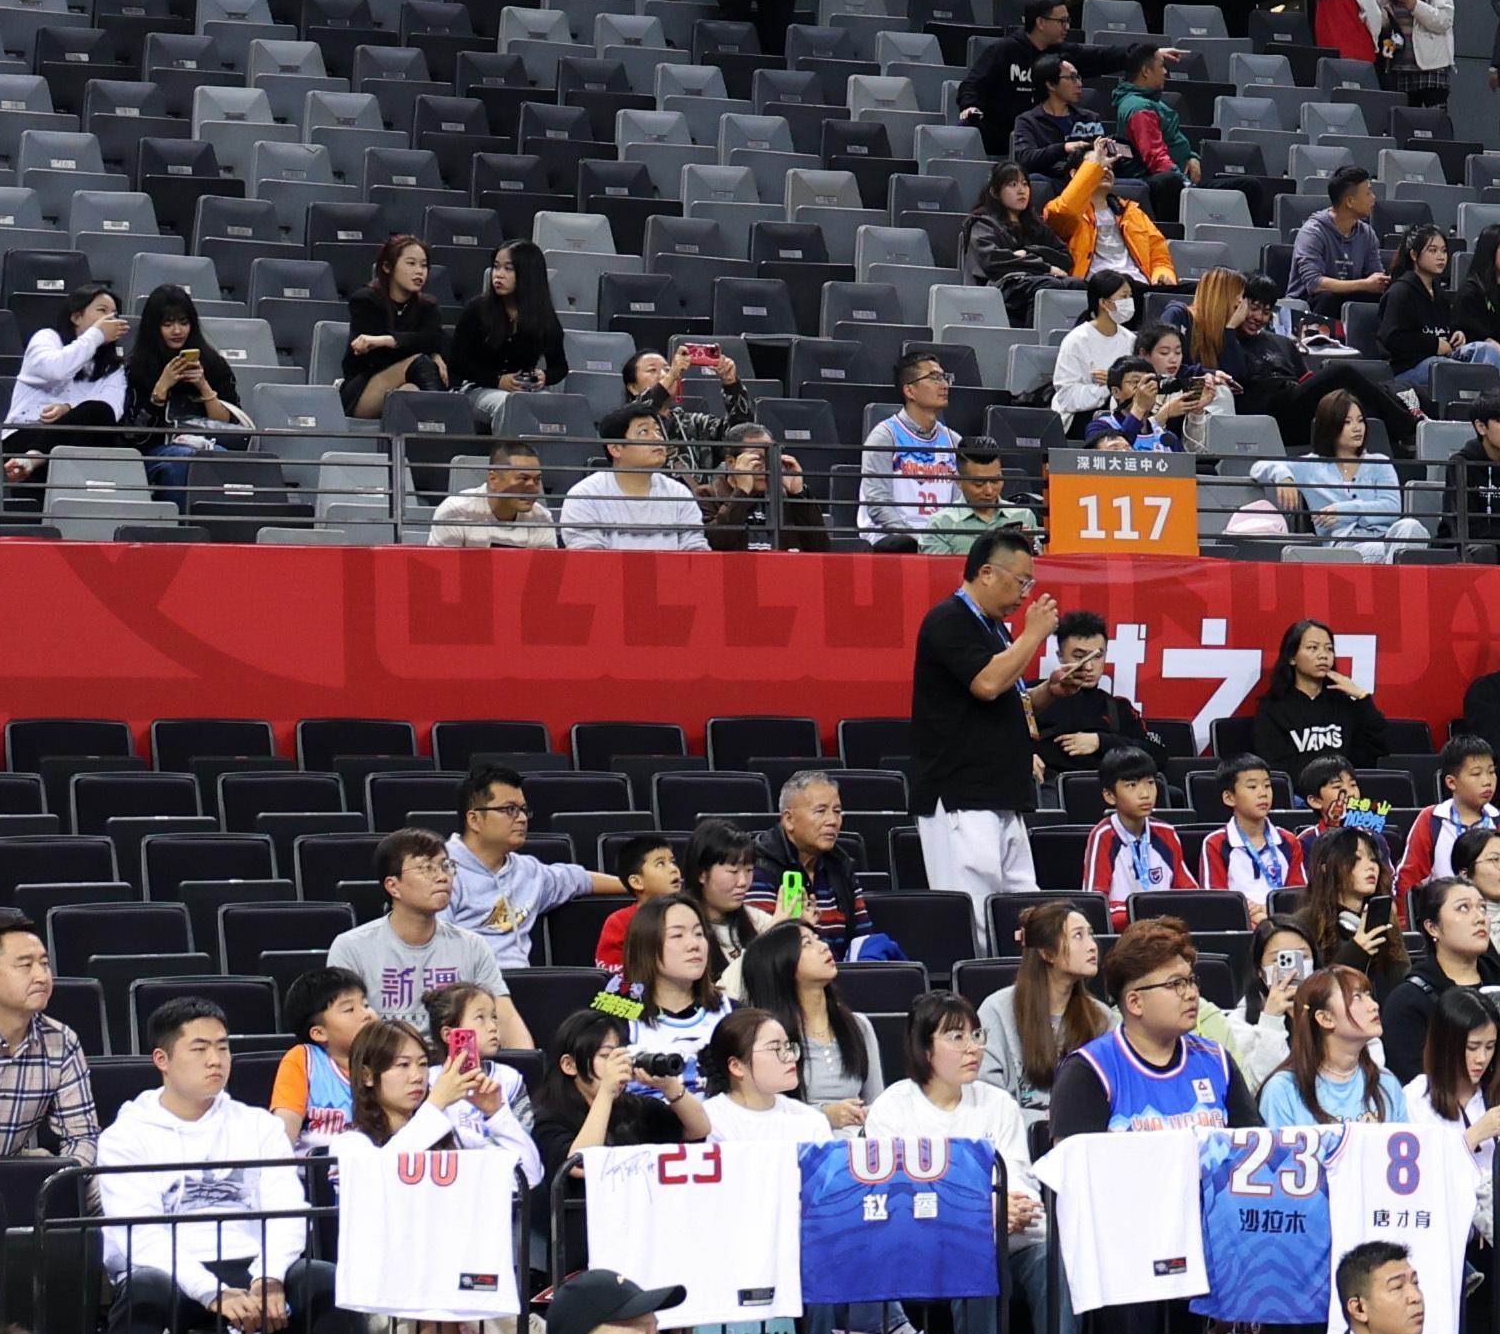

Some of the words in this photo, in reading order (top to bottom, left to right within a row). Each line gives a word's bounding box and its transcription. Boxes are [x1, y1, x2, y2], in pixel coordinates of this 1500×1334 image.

[1076, 455, 1170, 473] 深圳大运中心
[1078, 494, 1173, 541] 117
[1290, 723, 1343, 753] VANS
[1229, 1130, 1322, 1197] 23
[1386, 1130, 1421, 1197] 8
[862, 1192, 940, 1221] 赵睿
[1372, 1208, 1432, 1231] 唐才育
[1238, 1208, 1307, 1236] 沙拉木
